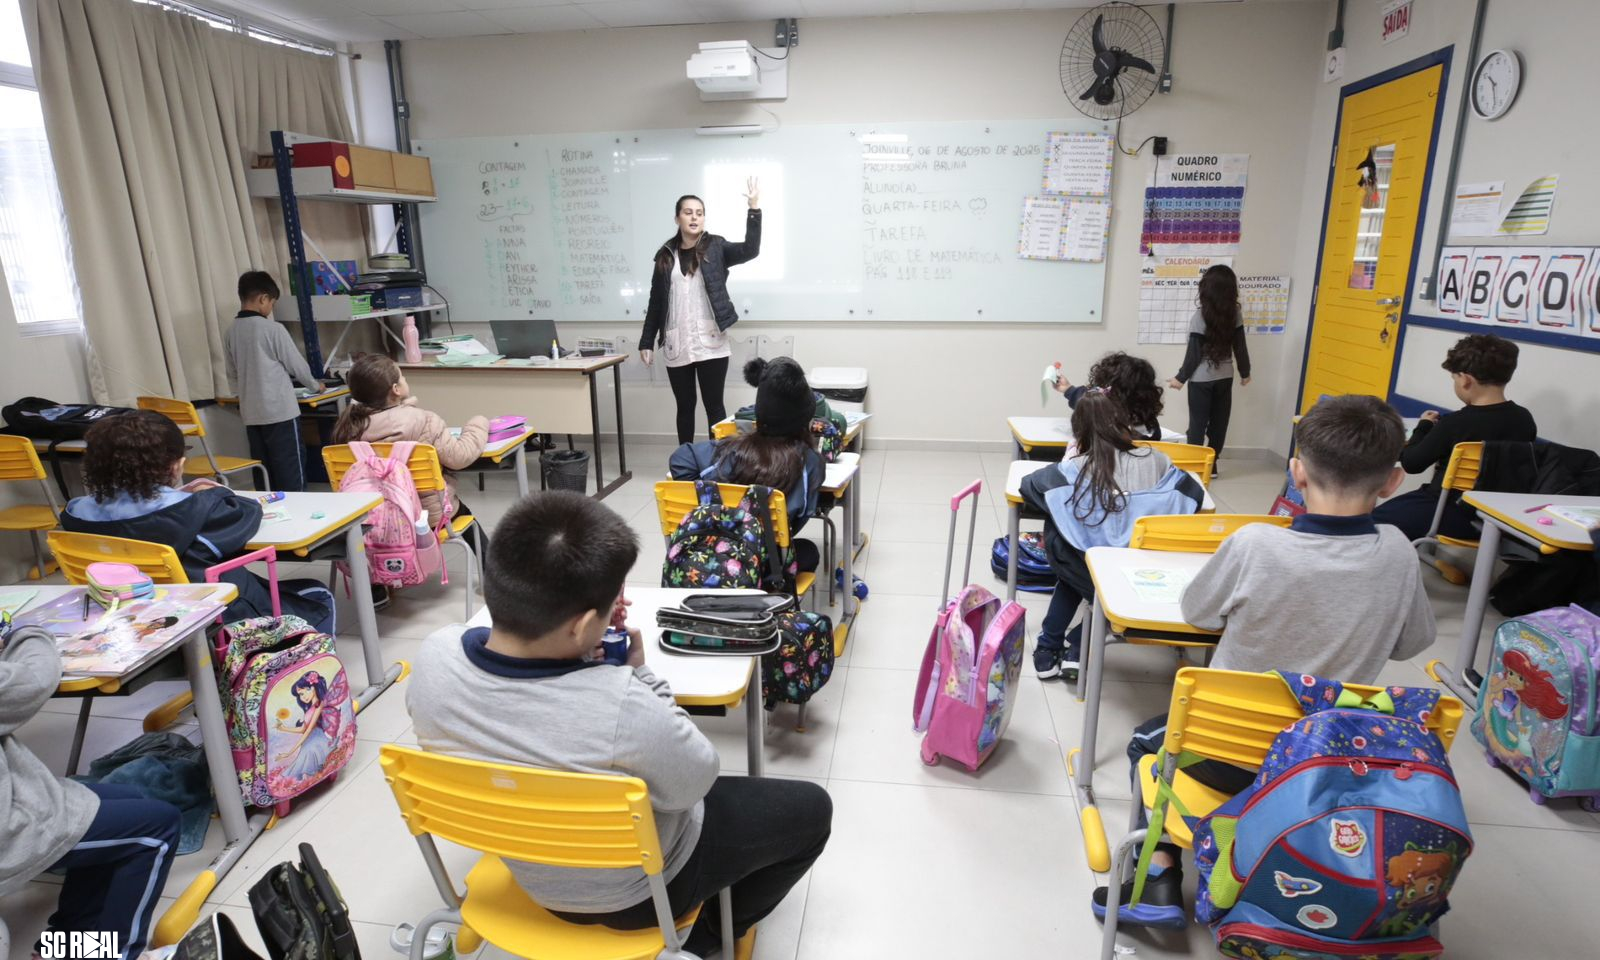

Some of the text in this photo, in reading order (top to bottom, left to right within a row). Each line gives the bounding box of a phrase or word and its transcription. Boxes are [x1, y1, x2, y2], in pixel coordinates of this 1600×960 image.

[1383, 7, 1408, 37] SAÍDA
[561, 148, 593, 162] ROTINA
[918, 146, 931, 156] 06
[937, 146, 950, 155] DE
[955, 145, 991, 156] AGOSTO
[995, 145, 1008, 155] DE
[1012, 144, 1041, 157] 2025
[478, 161, 526, 174] CONTAGEM
[933, 160, 967, 171] BRUNA
[1177, 156, 1218, 166] QUADRO
[560, 166, 600, 177] CHAMADA
[1171, 170, 1221, 182] NUMÉRICO
[862, 200, 962, 215] QUARTA-FEIRA
[864, 226, 927, 242] TAREFA
[907, 248, 922, 263] DE
[1164, 257, 1210, 265] CALENDÁRIO
[1142, 267, 1154, 275] MÊS
[1442, 268, 1459, 301] A
[1470, 270, 1491, 304] B
[1502, 270, 1528, 308] C
[1543, 271, 1569, 310] D
